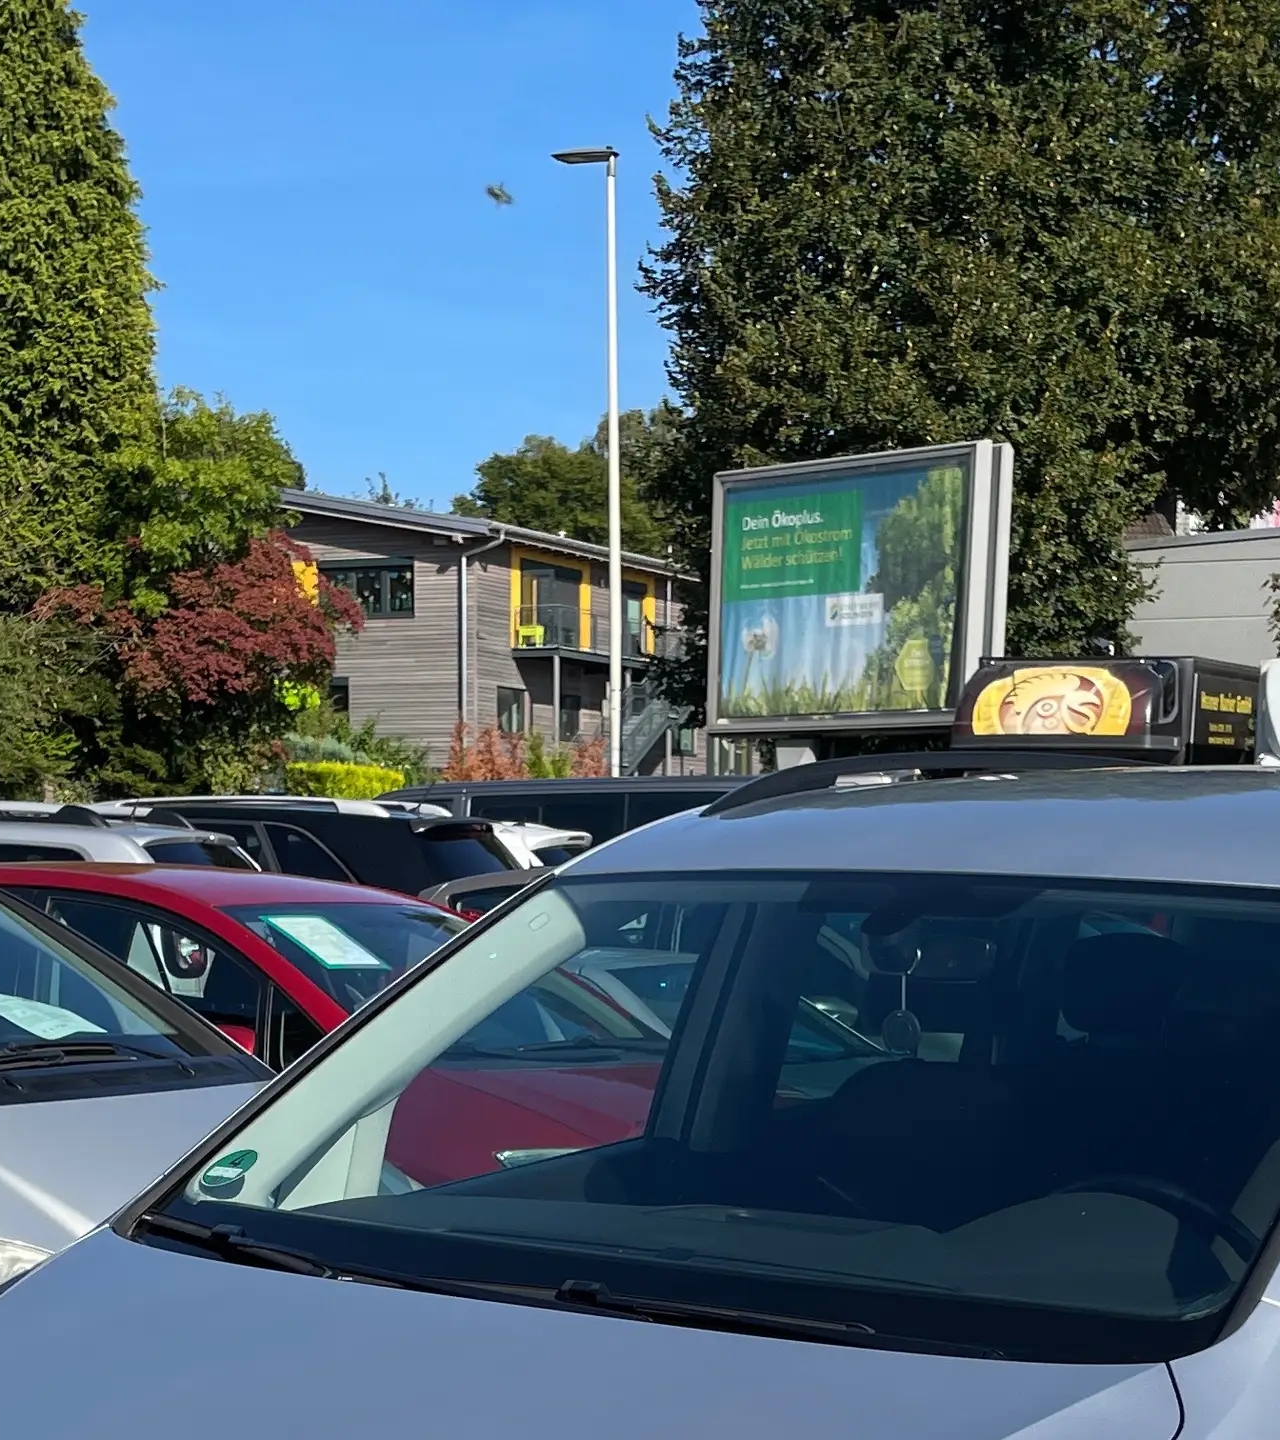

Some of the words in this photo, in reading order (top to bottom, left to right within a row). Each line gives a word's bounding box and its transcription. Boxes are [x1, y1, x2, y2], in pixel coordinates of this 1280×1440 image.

[742, 515, 769, 531] Dein
[771, 509, 824, 528] Ökoplus.
[741, 535, 769, 550] Jetzt
[772, 533, 791, 548] mit
[794, 528, 853, 545] Ökostrom
[741, 552, 783, 570] Wälder
